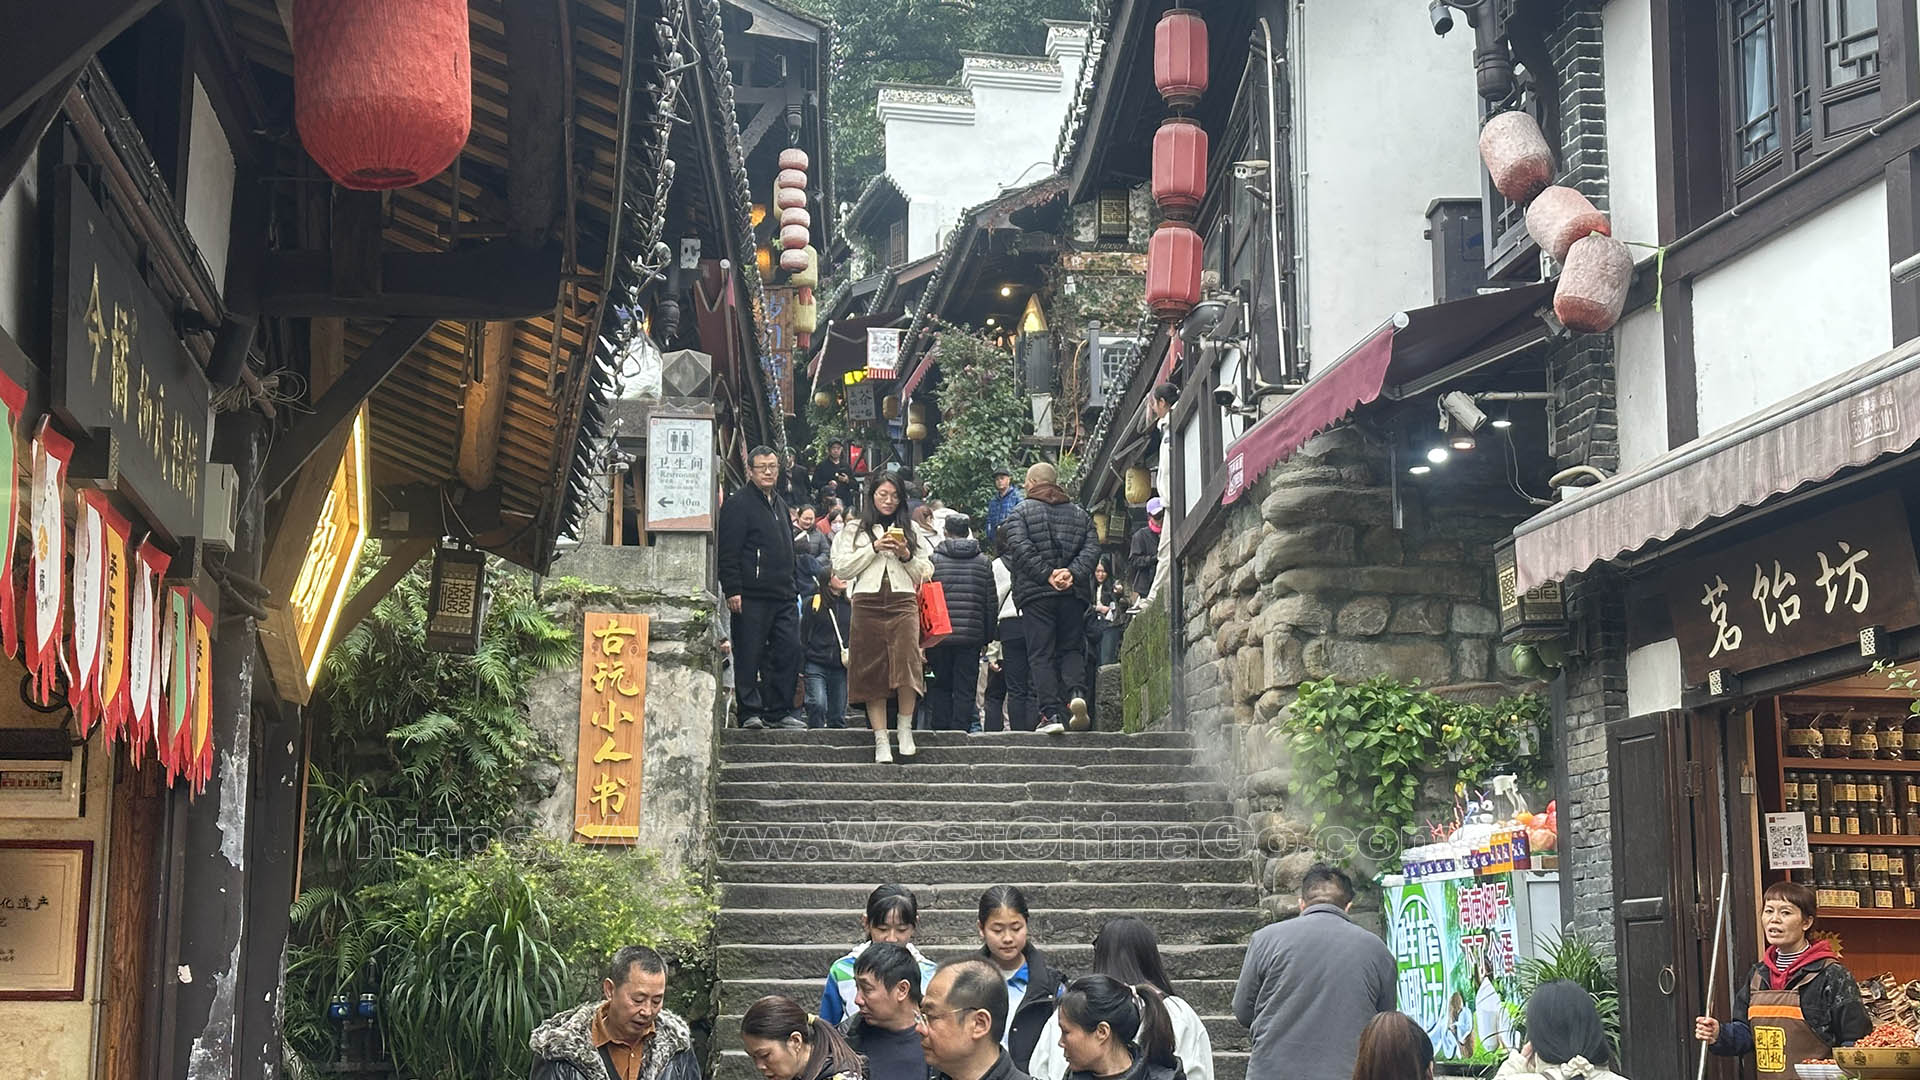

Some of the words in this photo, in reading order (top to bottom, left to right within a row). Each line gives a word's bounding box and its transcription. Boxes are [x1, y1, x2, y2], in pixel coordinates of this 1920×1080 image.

[656, 456, 703, 470] 卫生间
[590, 619, 639, 818] 古玩小人书
[1397, 901, 1441, 967] 鲜榨
[1457, 882, 1510, 930] 海南椰子
[1461, 930, 1515, 979] 下了个蛋
[1398, 967, 1443, 1033] 椰汁
